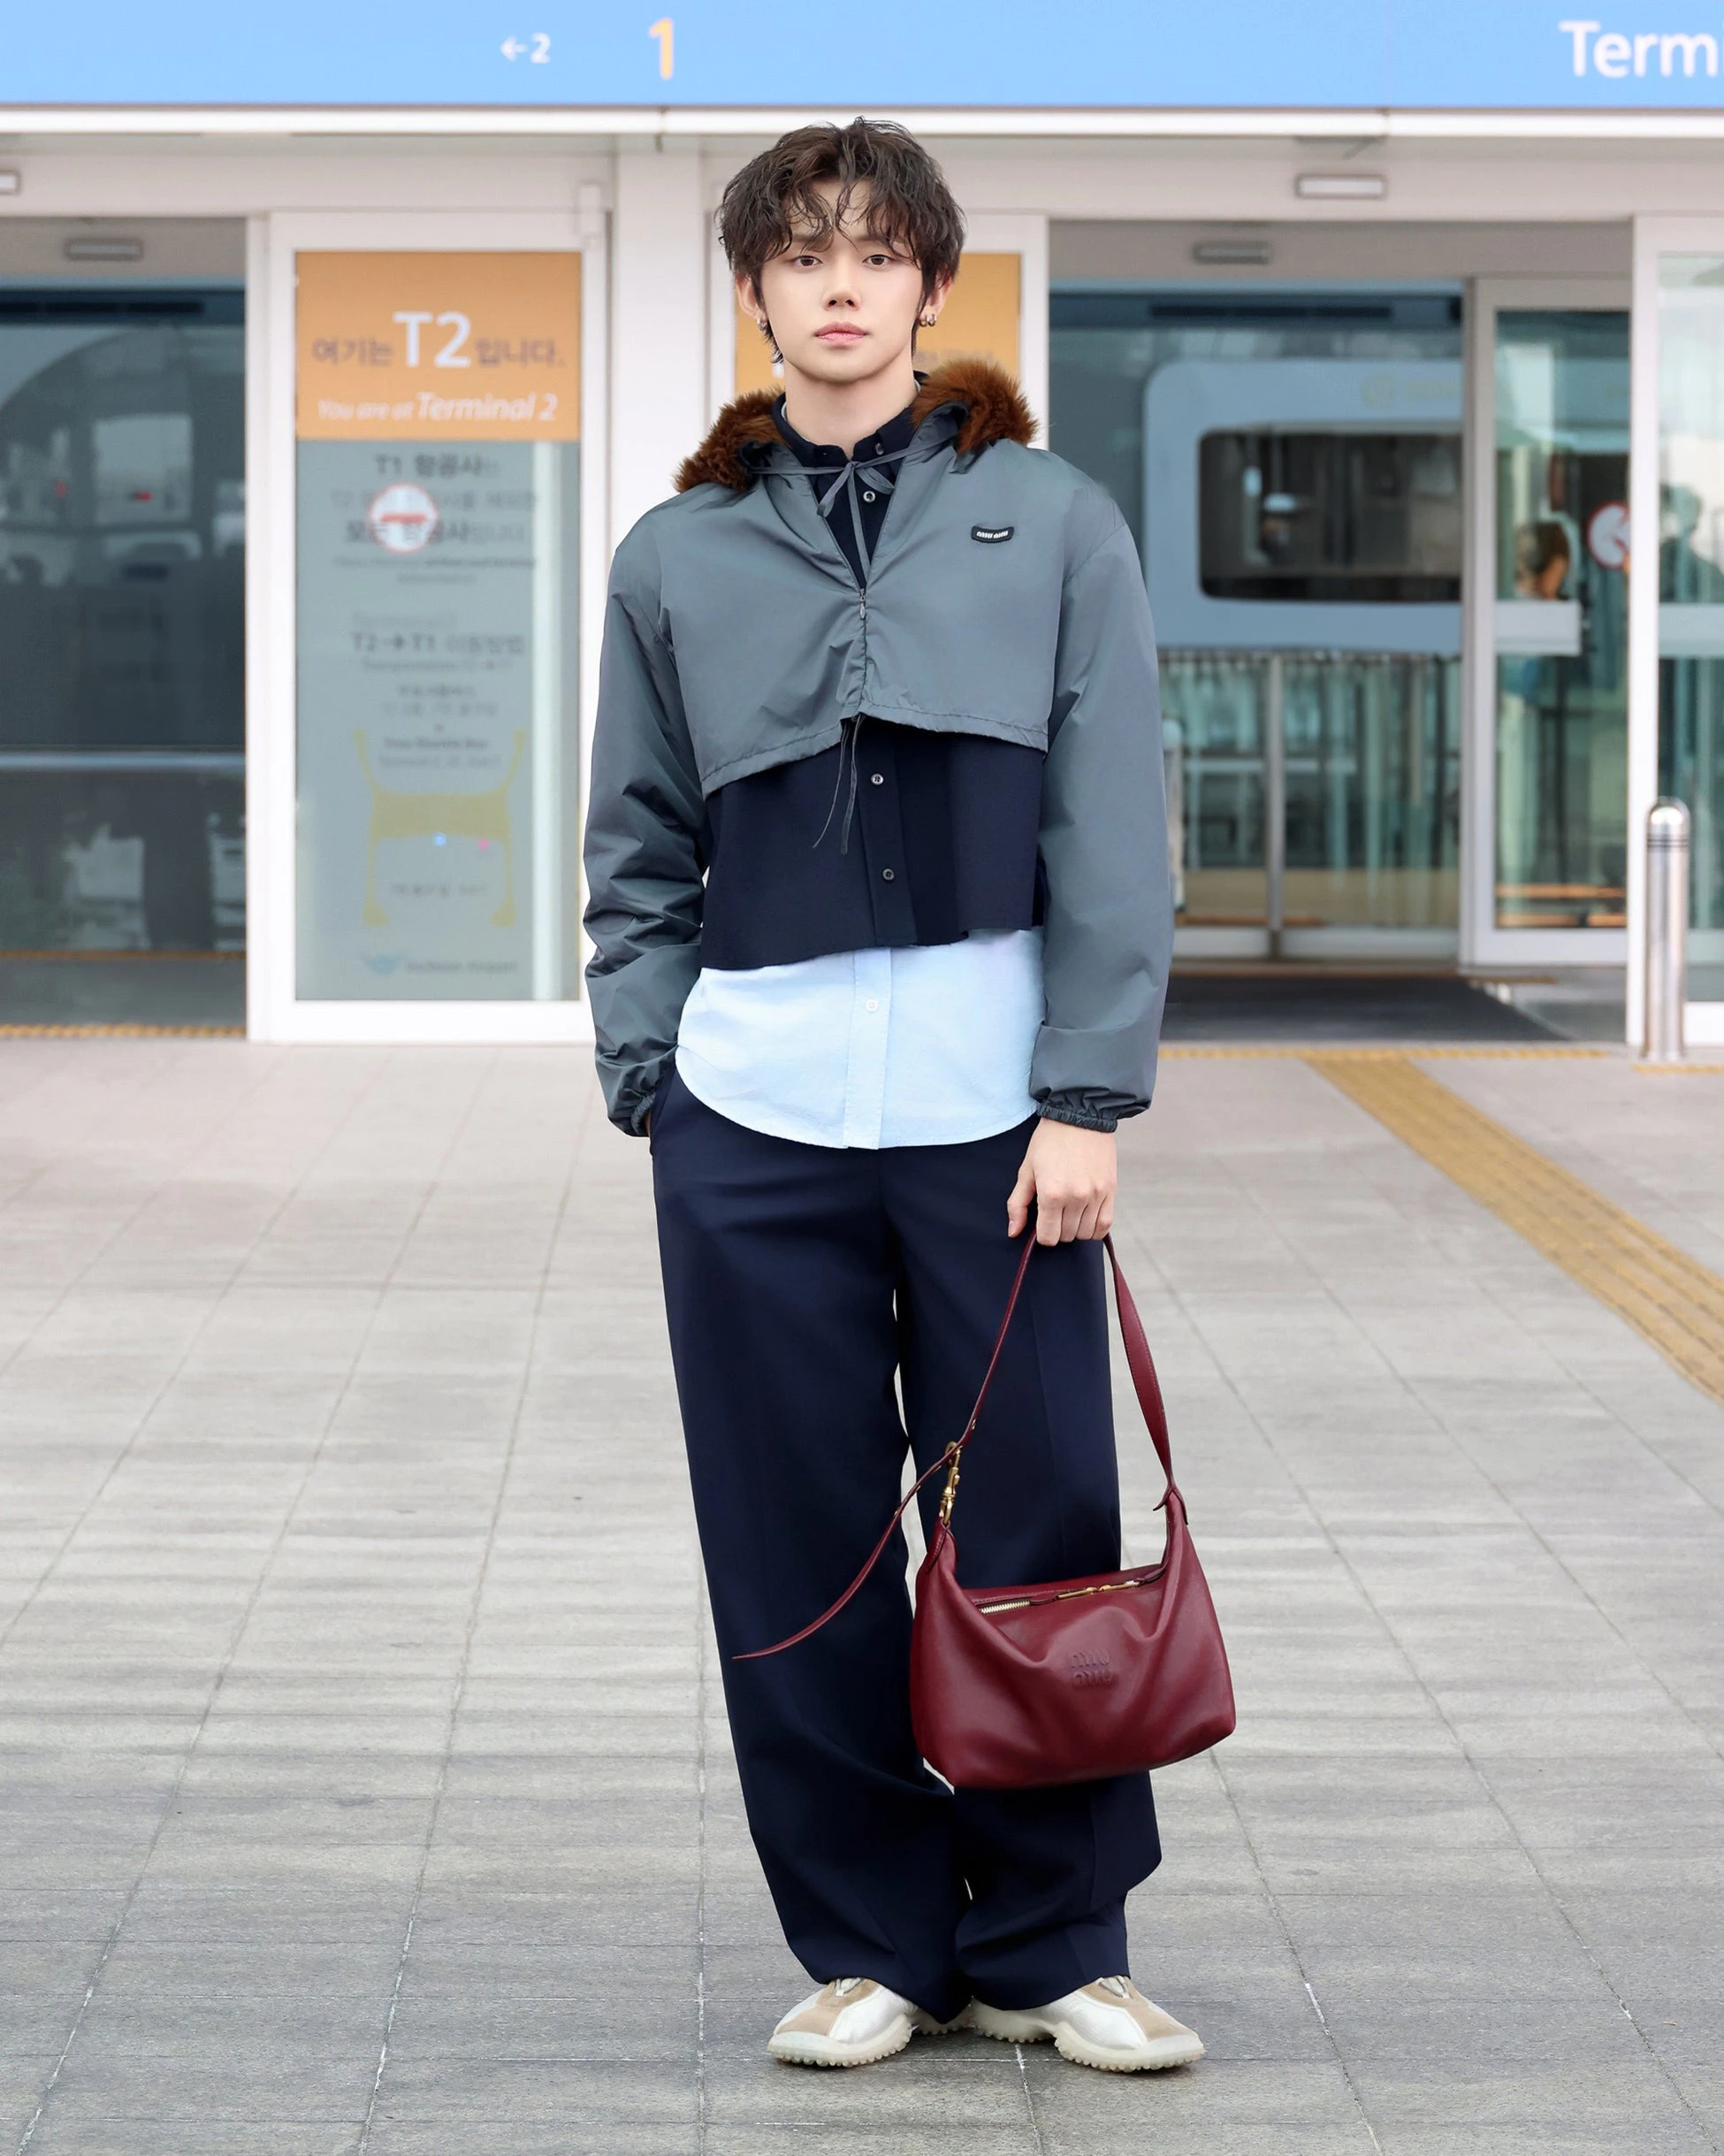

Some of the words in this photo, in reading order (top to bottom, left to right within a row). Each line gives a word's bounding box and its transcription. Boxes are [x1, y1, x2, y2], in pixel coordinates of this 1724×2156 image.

[530, 32, 551, 64] 2
[648, 17, 674, 80] 1
[1558, 19, 1724, 78] Term
[392, 310, 472, 368] T2
[416, 391, 537, 422] Terminal
[538, 393, 559, 421] 2
